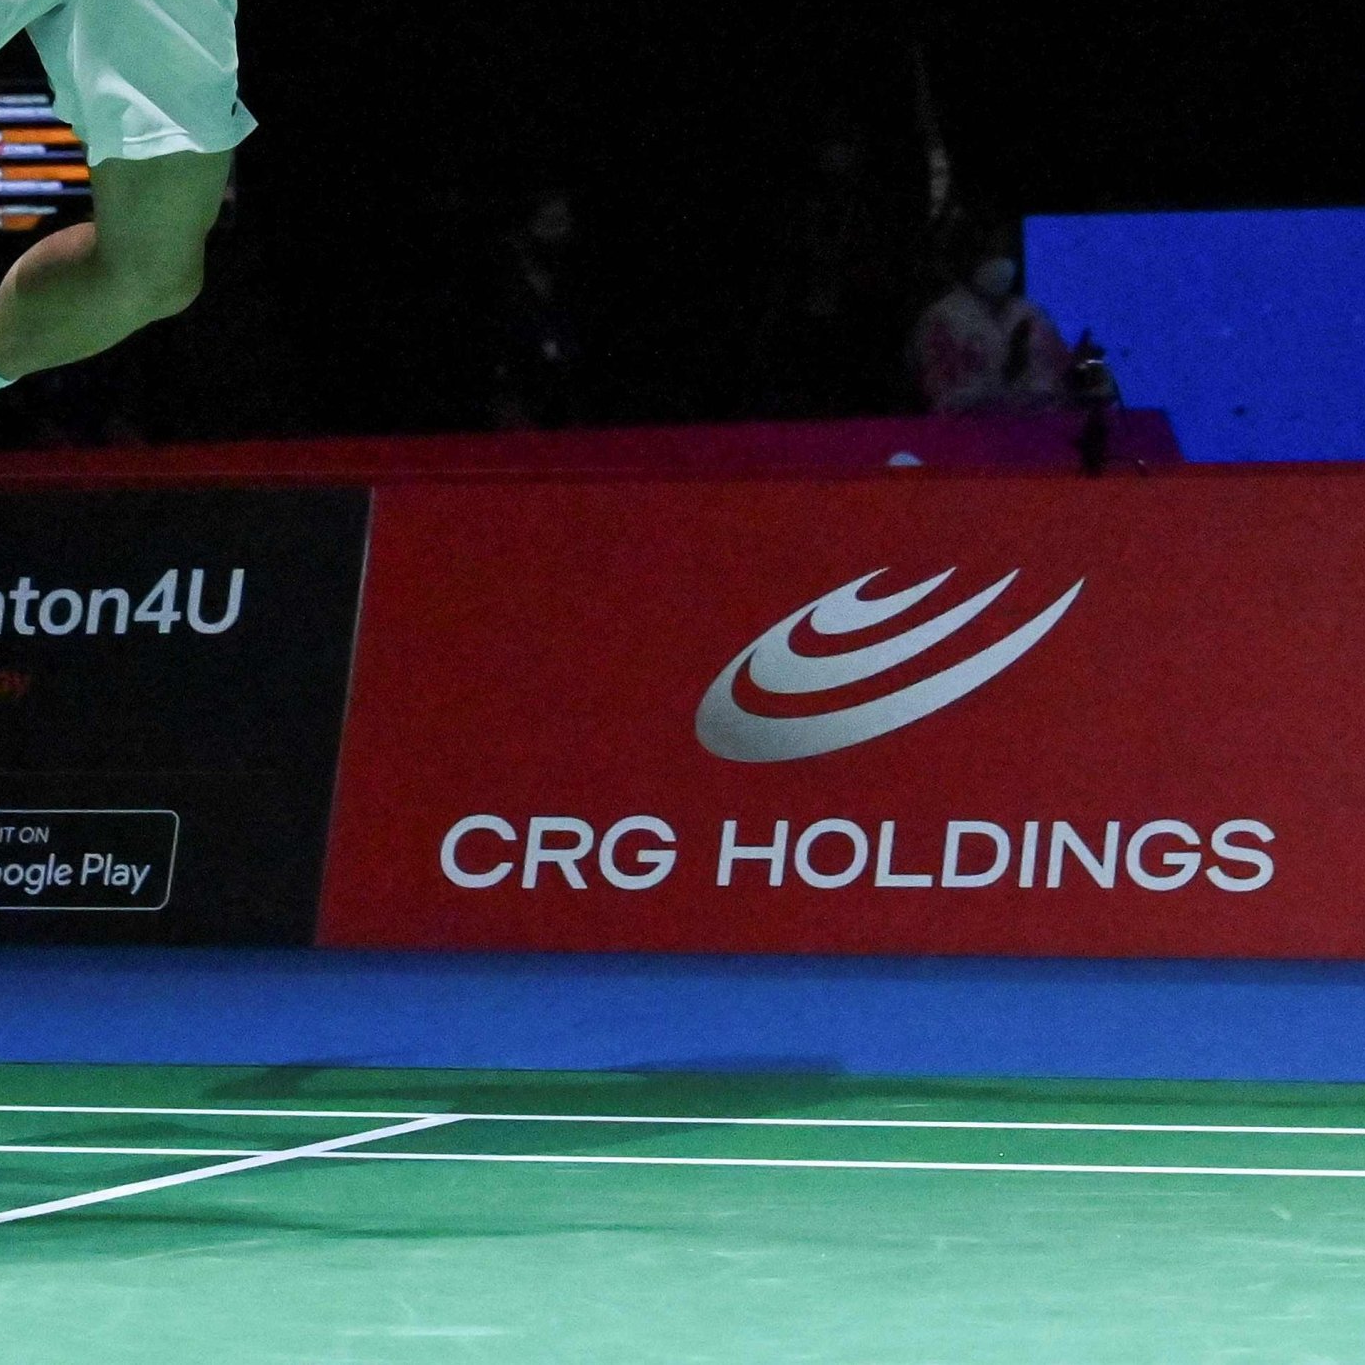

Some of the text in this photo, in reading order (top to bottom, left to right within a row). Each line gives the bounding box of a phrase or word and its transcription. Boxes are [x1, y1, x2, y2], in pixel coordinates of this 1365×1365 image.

[18, 826, 50, 844] ON
[439, 814, 1277, 893] CRG HOLDINGS
[80, 851, 152, 896] Play
